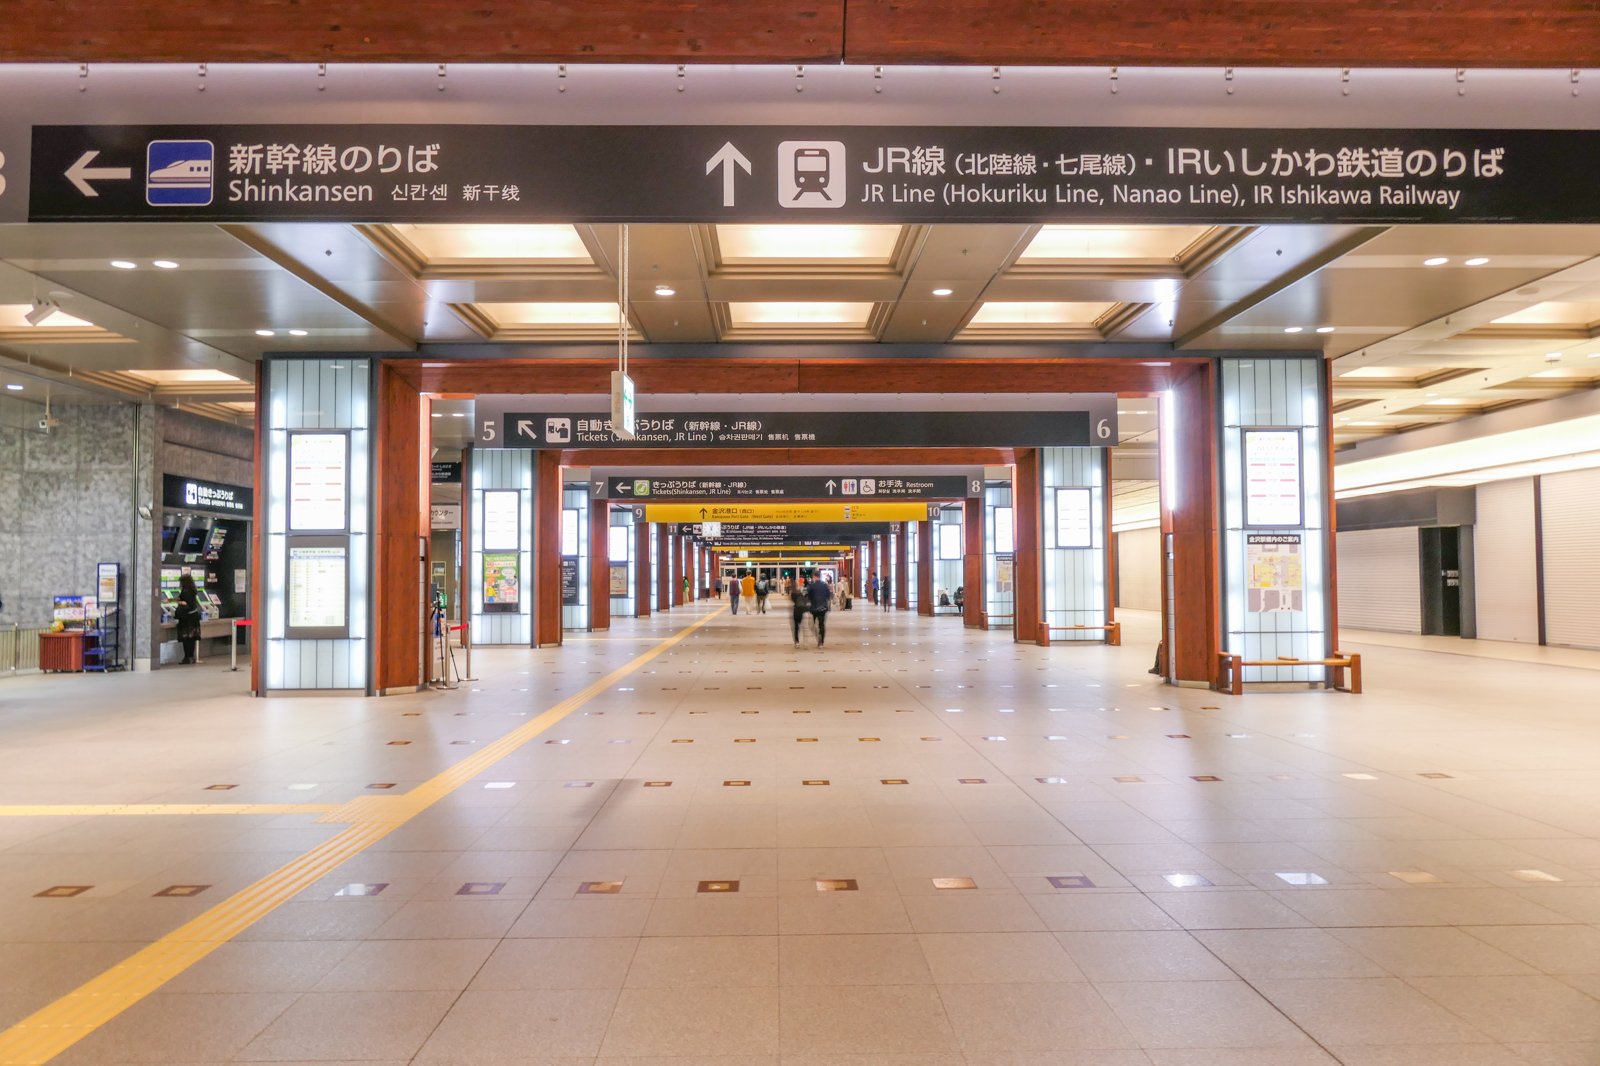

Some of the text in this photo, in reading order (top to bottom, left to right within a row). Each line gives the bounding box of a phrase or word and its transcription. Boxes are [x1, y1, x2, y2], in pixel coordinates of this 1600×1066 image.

[229, 143, 439, 174] 新幹線のりば
[229, 180, 373, 202] Shinkansen
[391, 183, 448, 202] 신칸센
[463, 184, 520, 202] 新干线
[861, 183, 1460, 210] JR Line (Hokuriku Line, Nanao Line), IR Ishikawa Railway
[482, 421, 496, 441] 5
[1096, 418, 1111, 439] 6
[576, 432, 608, 441] Tickets
[674, 433, 685, 441] JR
[688, 432, 707, 441] Line
[595, 481, 605, 495] 7
[878, 479, 903, 488] お手洗
[971, 480, 981, 493] 8
[635, 508, 643, 519] 9
[927, 506, 940, 517] 10
[669, 525, 677, 533] 11
[890, 523, 900, 532] 12
